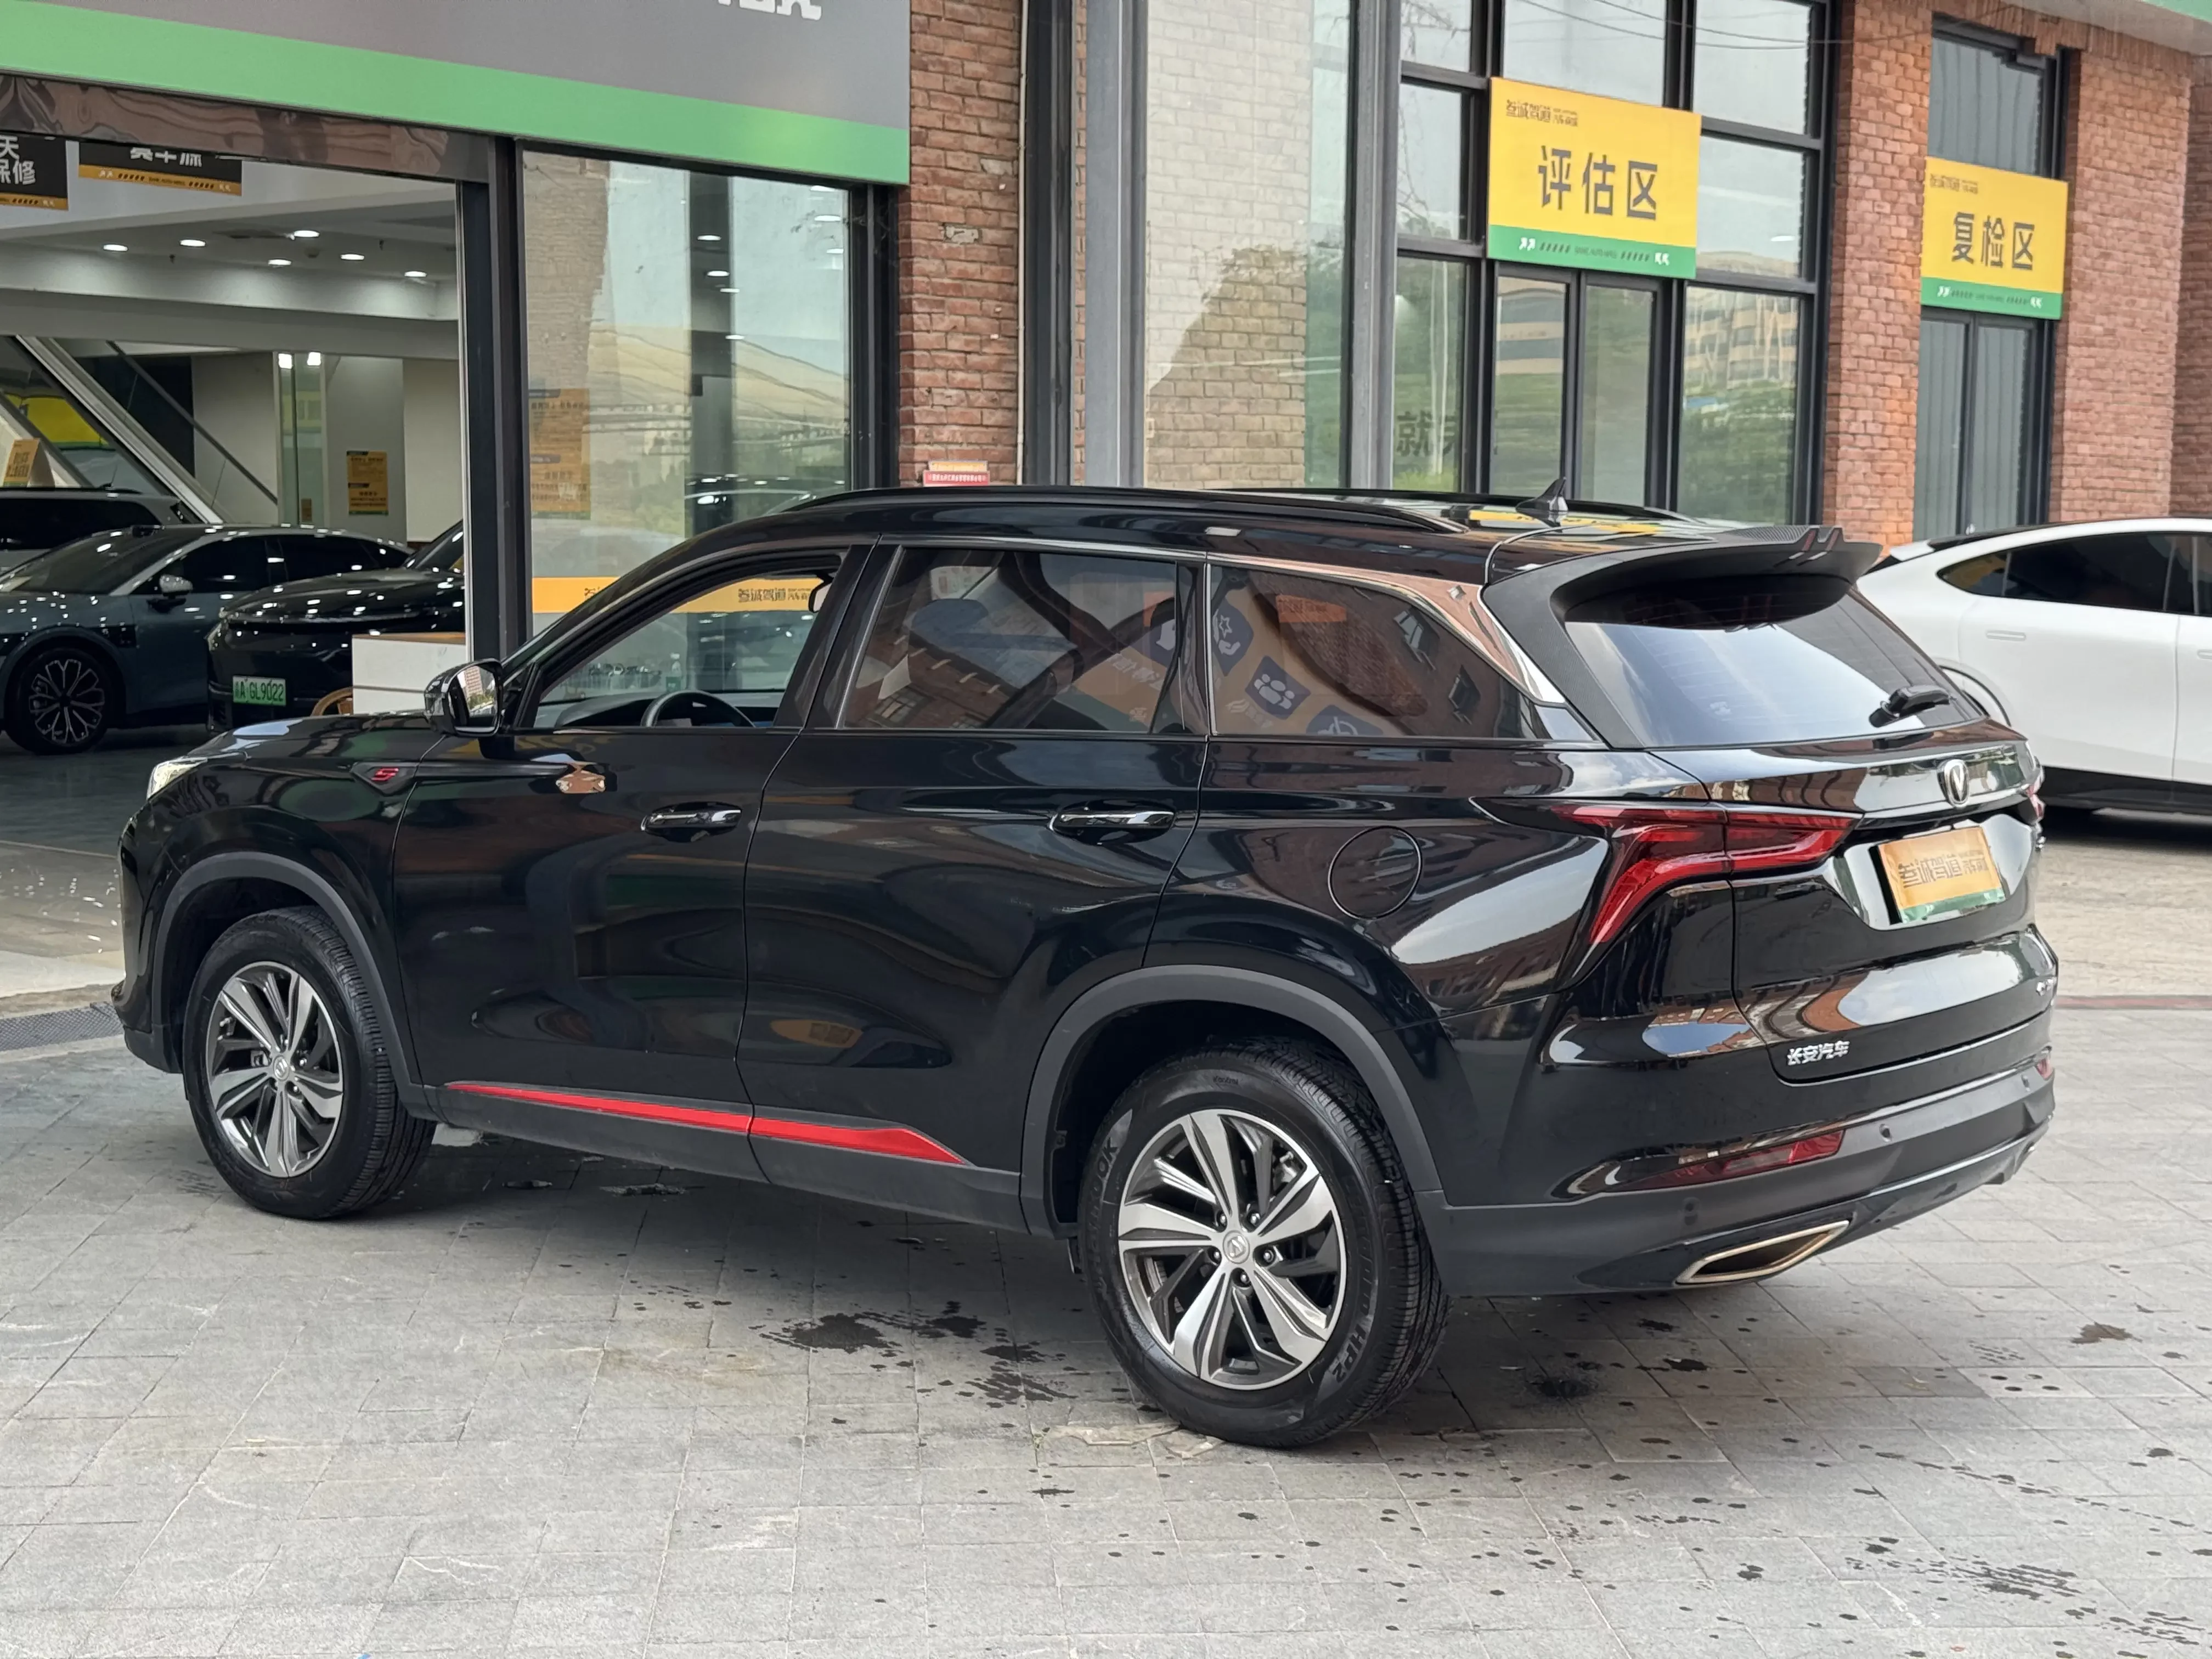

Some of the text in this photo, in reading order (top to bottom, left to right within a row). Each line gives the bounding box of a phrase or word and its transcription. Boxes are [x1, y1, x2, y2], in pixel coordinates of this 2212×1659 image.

[0, 135, 20, 160] 天
[1538, 145, 1658, 221] 评估区
[1952, 212, 2035, 270] 复检区
[1787, 1041, 1849, 1065] 长安汽车
[1331, 1323, 1368, 1384] HP2
